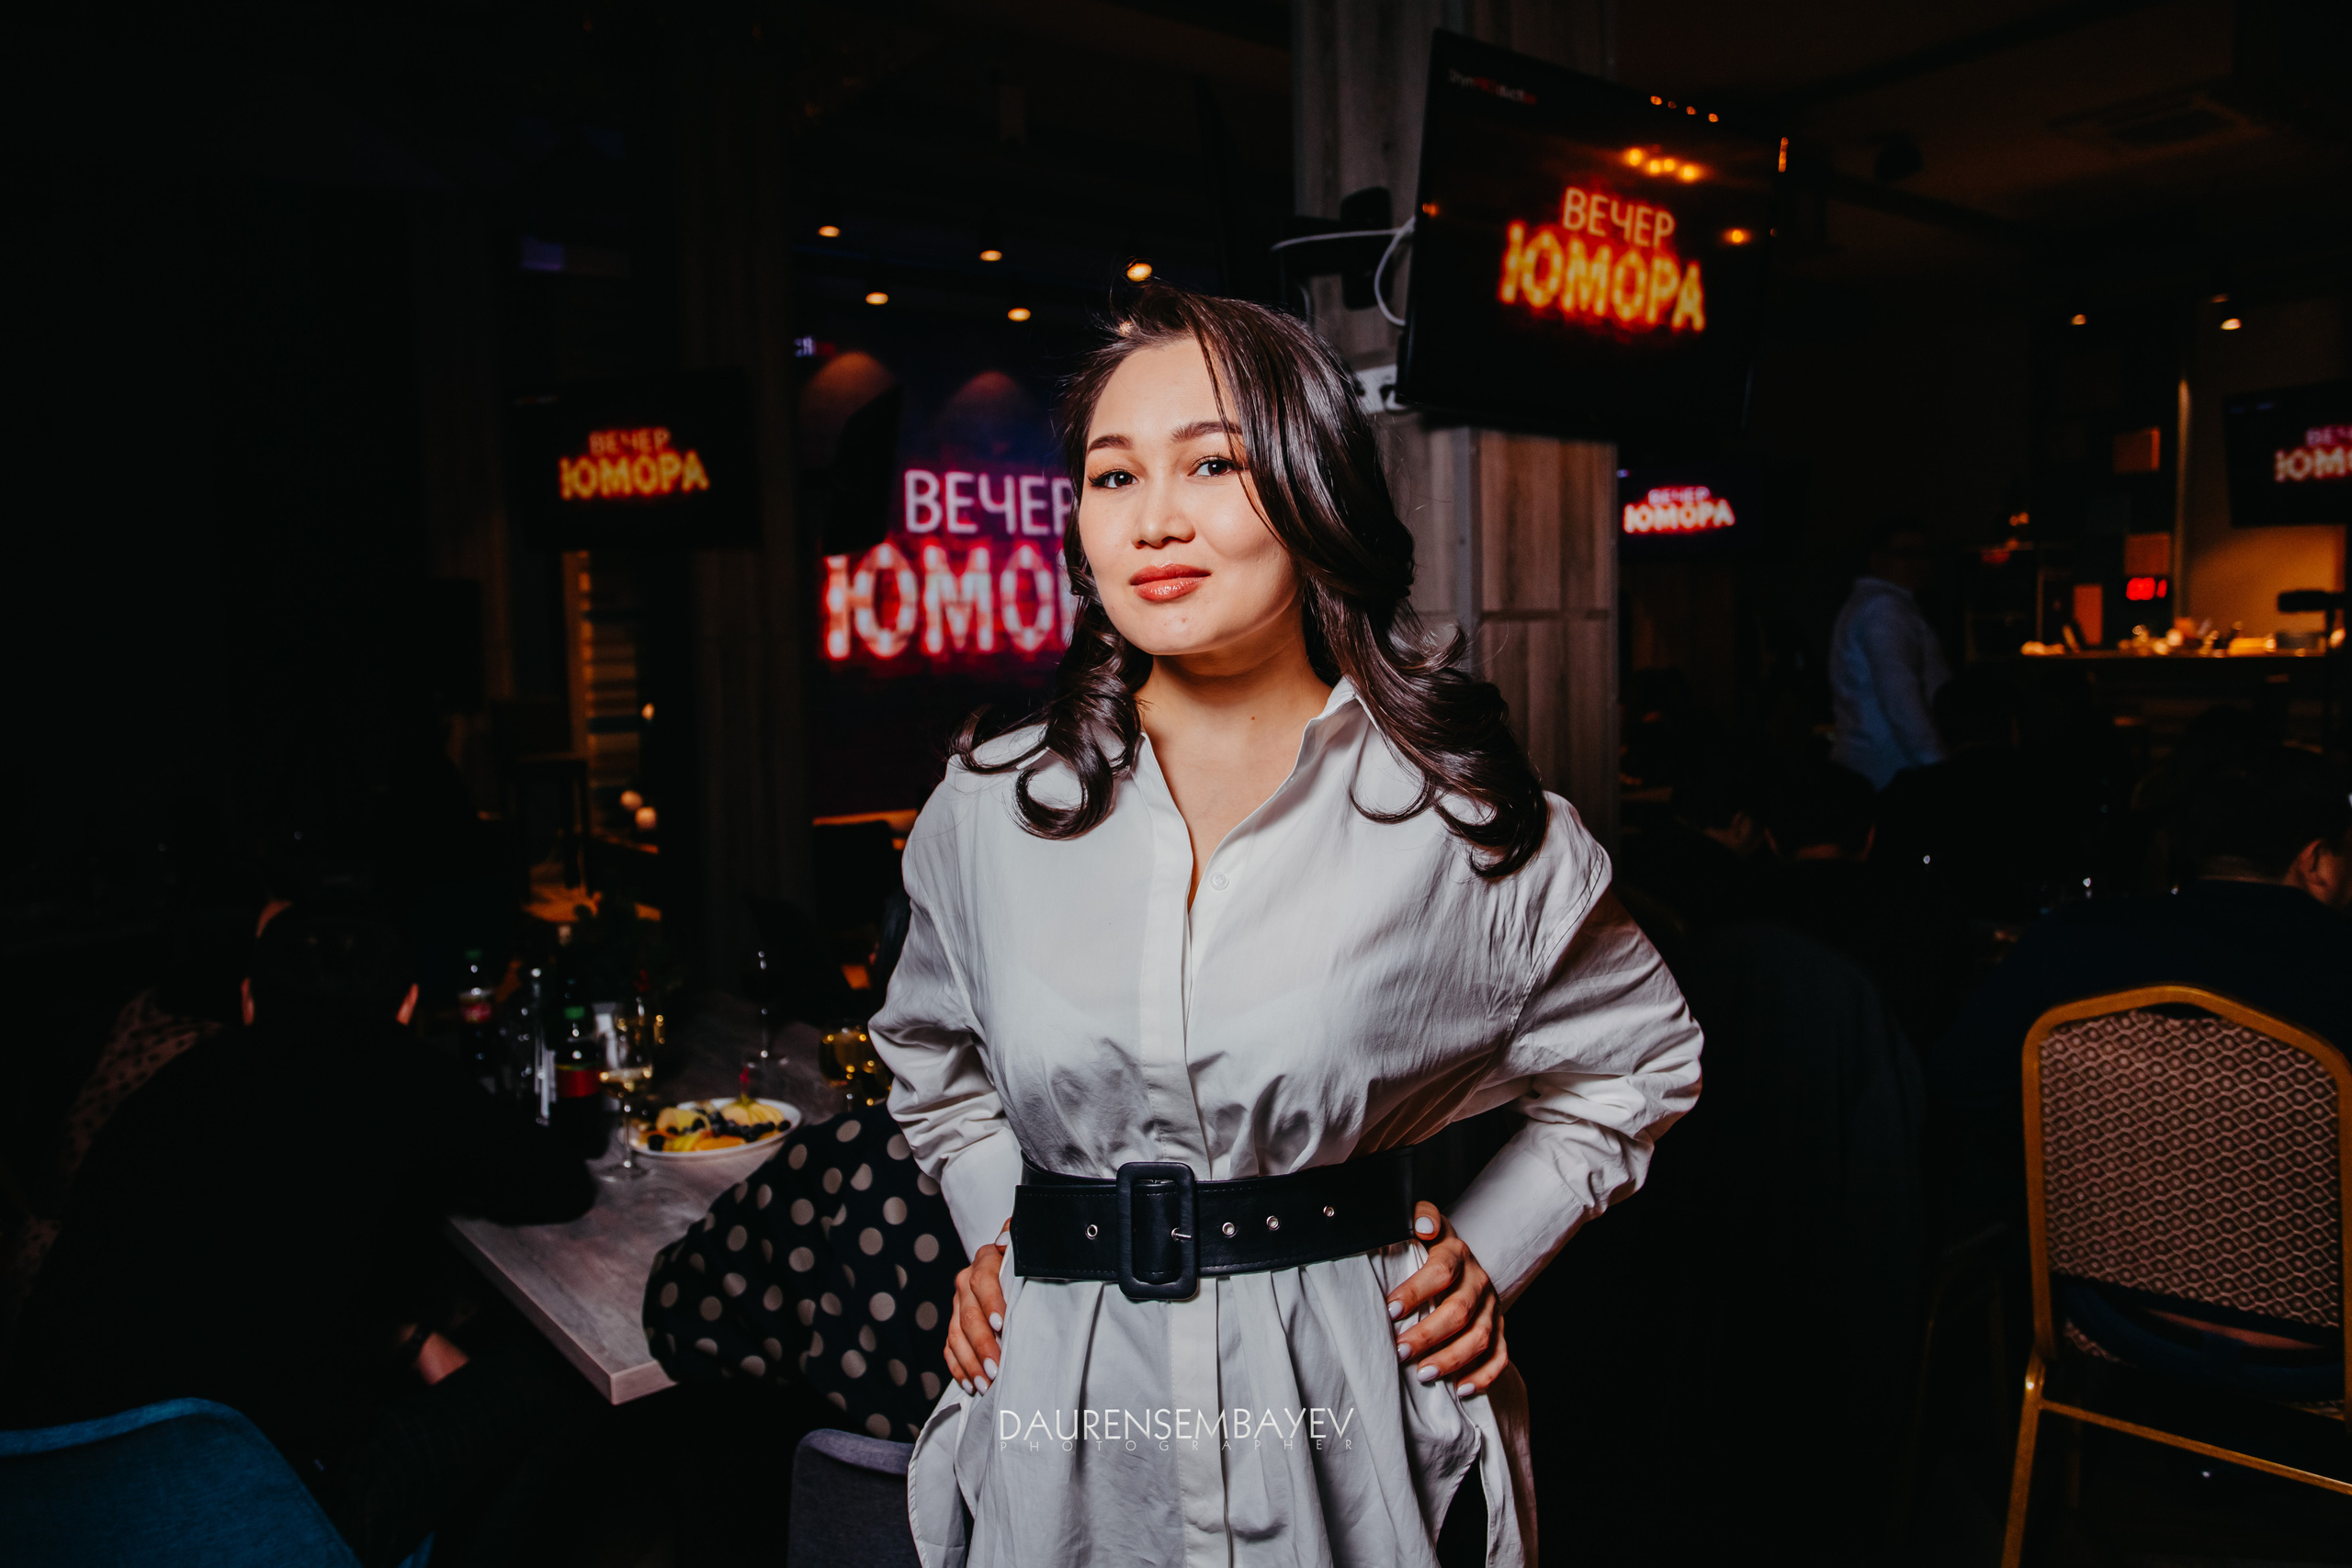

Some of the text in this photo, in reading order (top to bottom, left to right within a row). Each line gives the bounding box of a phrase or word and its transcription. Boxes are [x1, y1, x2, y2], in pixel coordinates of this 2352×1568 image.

[1563, 186, 1676, 247] ВЕЧЕР
[1498, 221, 1706, 333] ЮМОРА
[589, 427, 672, 457] ВЕЧЕР
[560, 450, 709, 501] ЮМОРА
[2274, 446, 2352, 483] ЮМ
[1623, 499, 1736, 533] ЮМОРА
